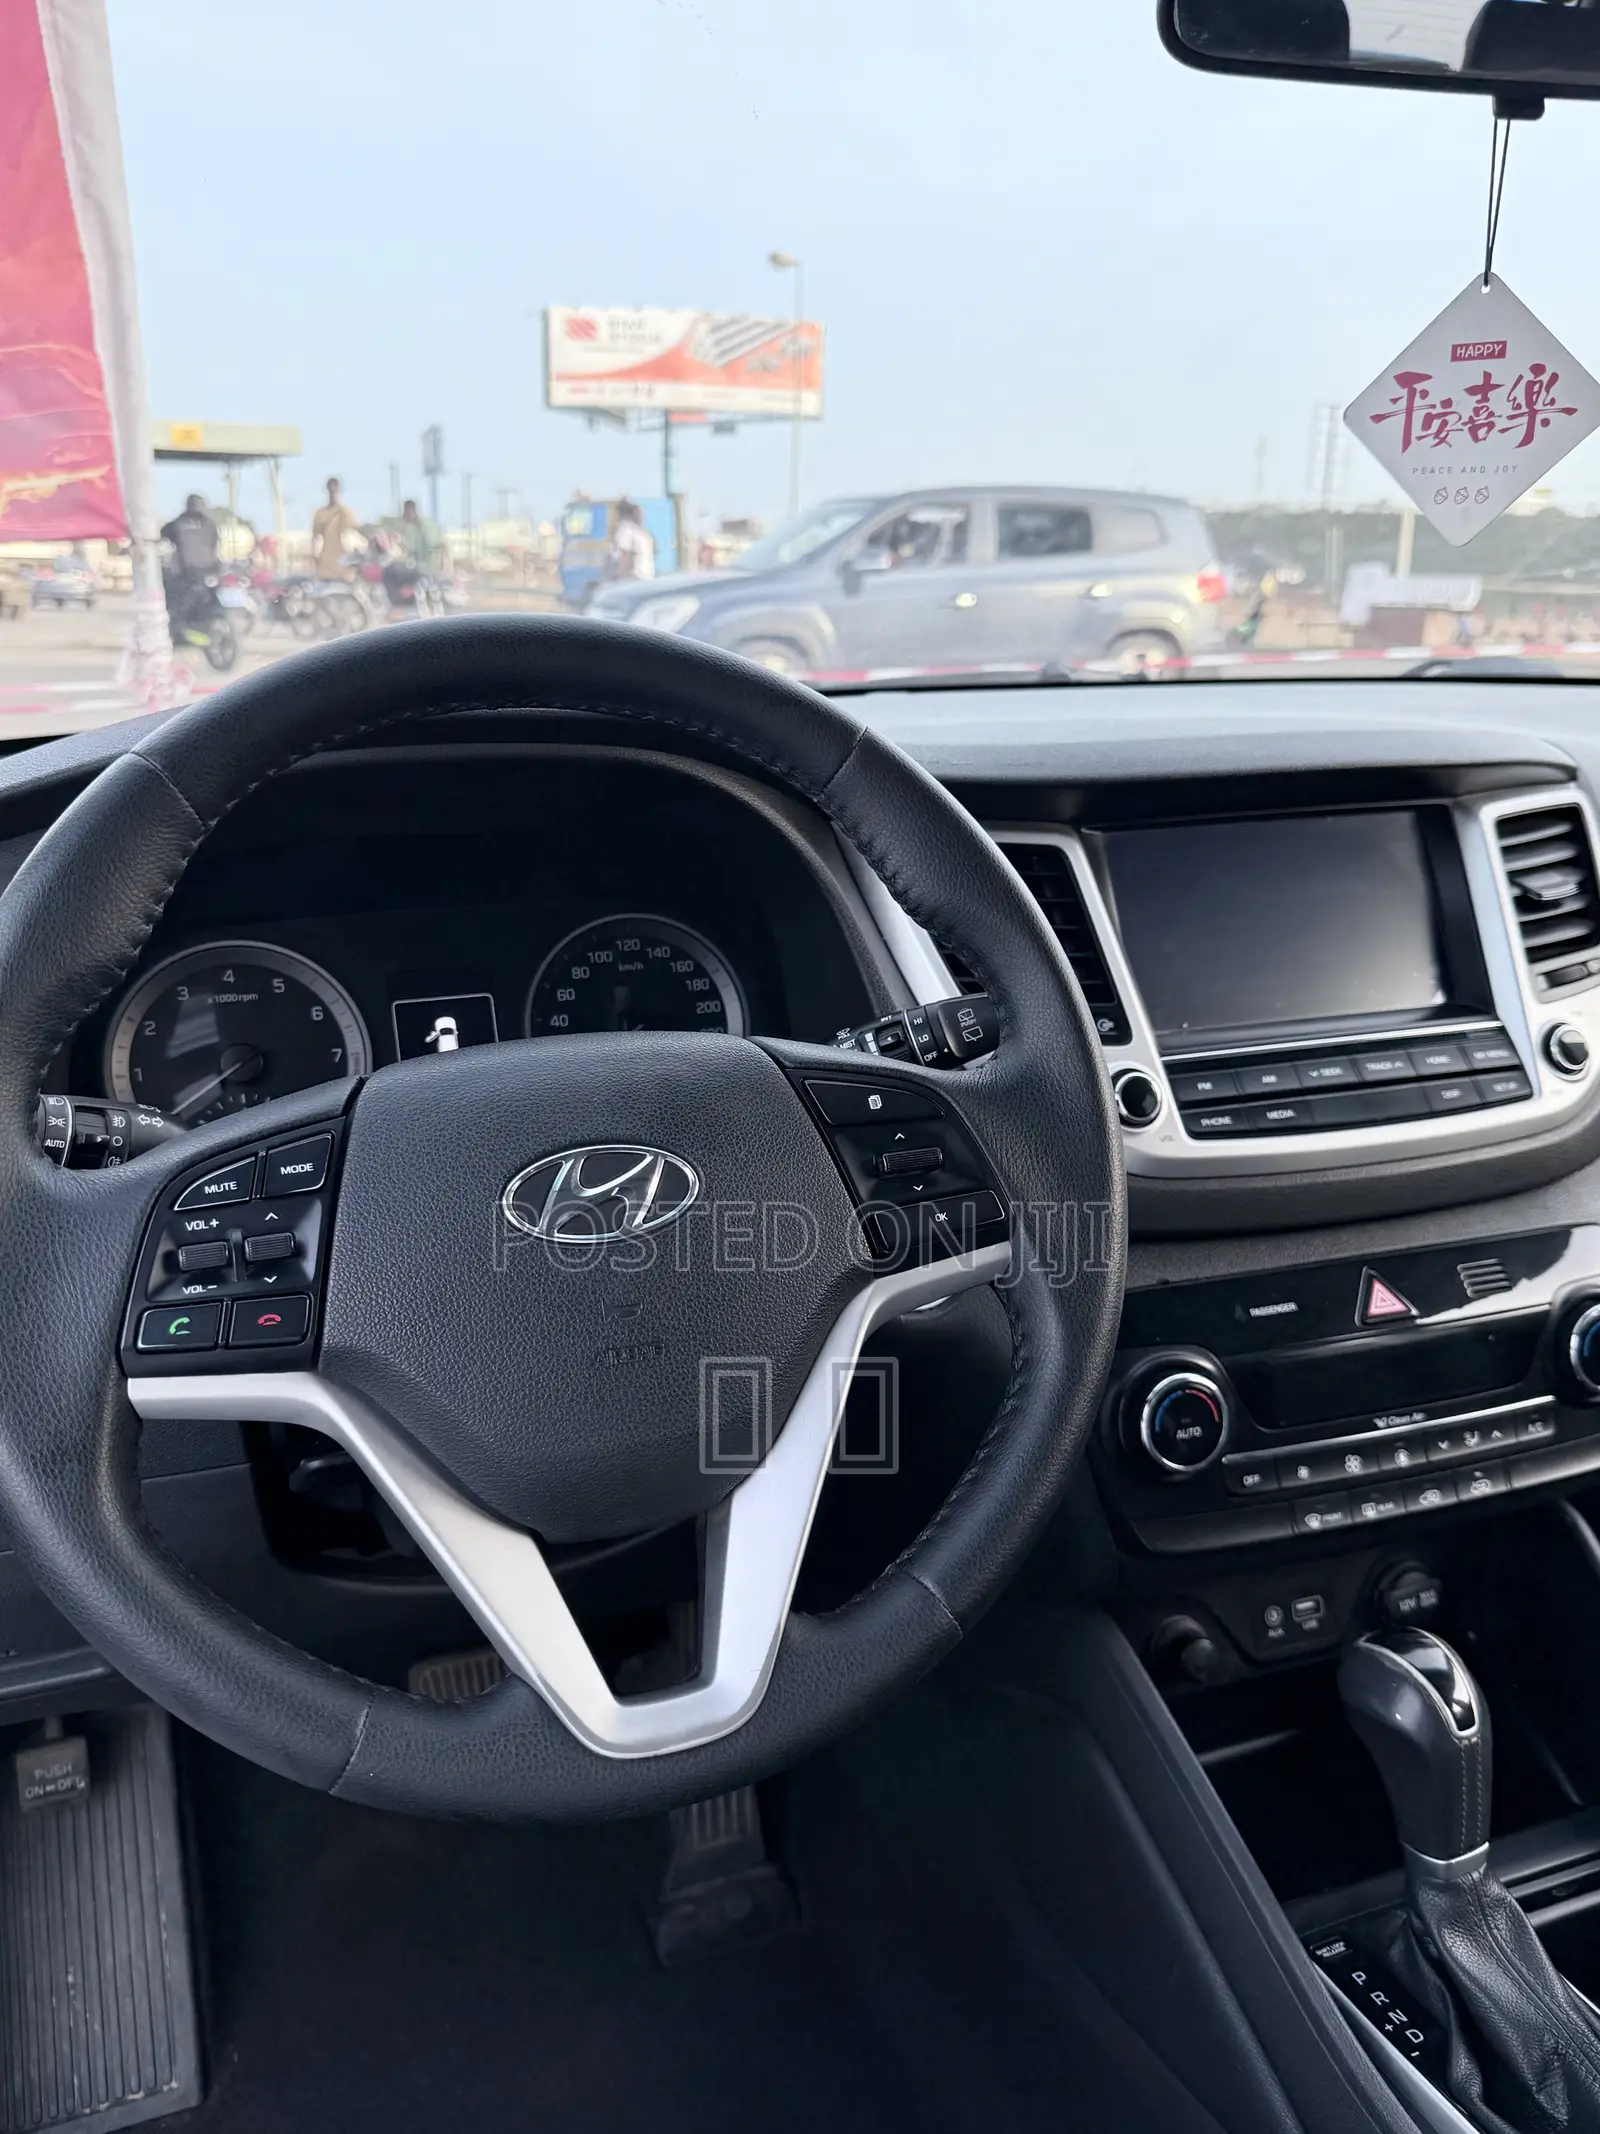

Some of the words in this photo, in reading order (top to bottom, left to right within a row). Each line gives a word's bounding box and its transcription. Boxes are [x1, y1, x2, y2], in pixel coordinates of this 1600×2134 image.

[1456, 344, 1503, 358] HAPPY
[1369, 362, 1579, 455] 平安喜樂
[1412, 466, 1454, 475] PEACE
[1461, 465, 1487, 474] AND
[1494, 464, 1519, 474] JOY
[616, 939, 641, 952] 120
[646, 946, 671, 959] 140
[588, 951, 613, 964] 100
[571, 966, 591, 980] 80
[618, 962, 644, 971] km/h
[670, 960, 694, 974] 160
[222, 969, 236, 984] 4
[273, 978, 286, 993] 5
[685, 979, 710, 991] 180
[177, 986, 189, 1001] 3
[557, 988, 576, 1002] 60
[311, 1006, 324, 1021] 6
[696, 1001, 721, 1014] 200
[550, 1015, 569, 1028] 40
[913, 1017, 923, 1025] HI
[144, 1021, 156, 1036] 2
[918, 1034, 929, 1043] LO
[331, 1049, 343, 1063] 7
[924, 1051, 938, 1062] OFF
[134, 1068, 143, 1082] 1
[1200, 1115, 1233, 1127] PHONE
[1266, 1108, 1297, 1121] MEDIA
[44, 1138, 66, 1148] AUTO
[280, 1162, 314, 1175] MODE
[204, 1181, 238, 1194] MUTE
[935, 1212, 949, 1222] OK
[1249, 1301, 1299, 1318] PASSENGER
[1176, 1426, 1203, 1439] AUTO
[1243, 1474, 1262, 1488] OFF
[34, 1762, 73, 1780] PUSH
[1351, 1971, 1367, 1985] P
[1370, 1991, 1389, 2005] R
[1388, 2009, 1408, 2025] N
[1405, 2029, 1424, 2043] D
